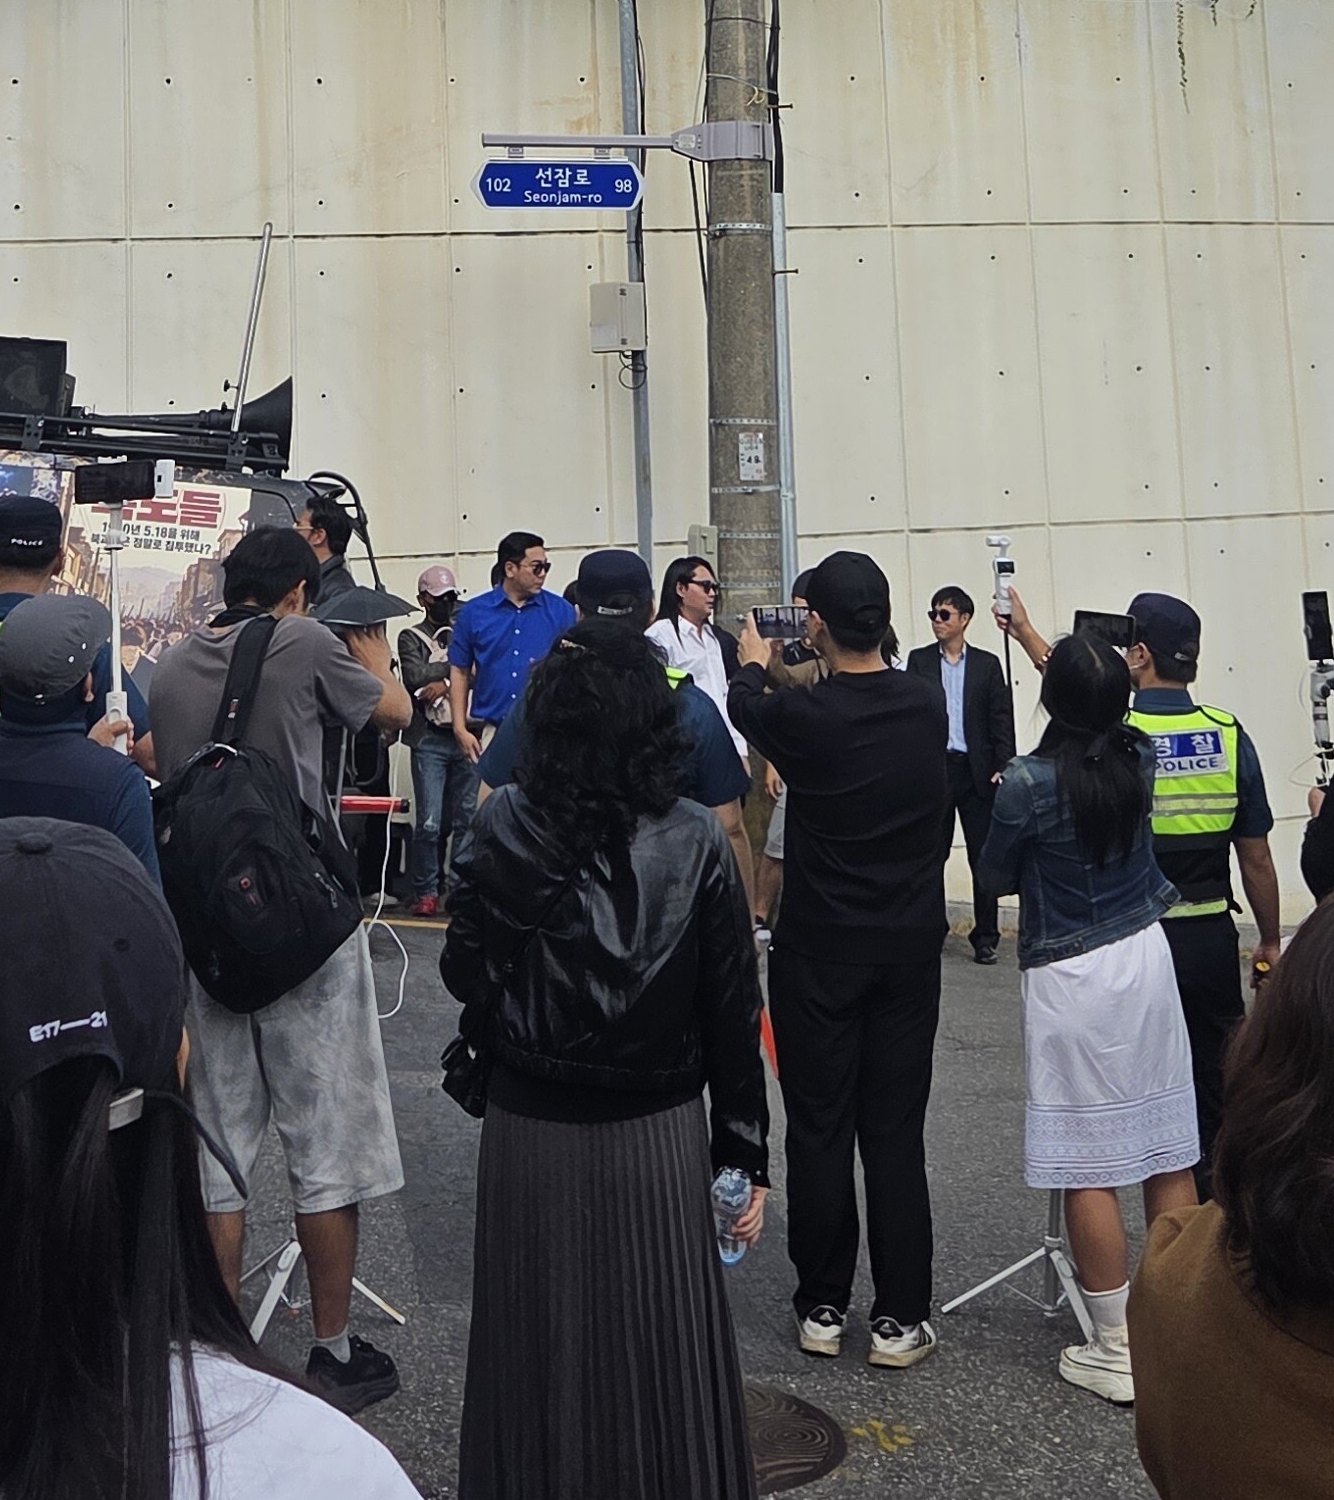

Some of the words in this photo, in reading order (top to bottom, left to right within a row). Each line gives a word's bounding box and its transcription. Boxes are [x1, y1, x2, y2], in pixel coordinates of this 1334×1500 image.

[485, 178, 512, 192] 102
[535, 167, 592, 188] 선잠로
[614, 179, 633, 193] 98
[523, 190, 603, 205] Seonjam-ro
[91, 488, 223, 529] 도들
[102, 521, 141, 536] 10년
[10, 538, 43, 546] POLICE
